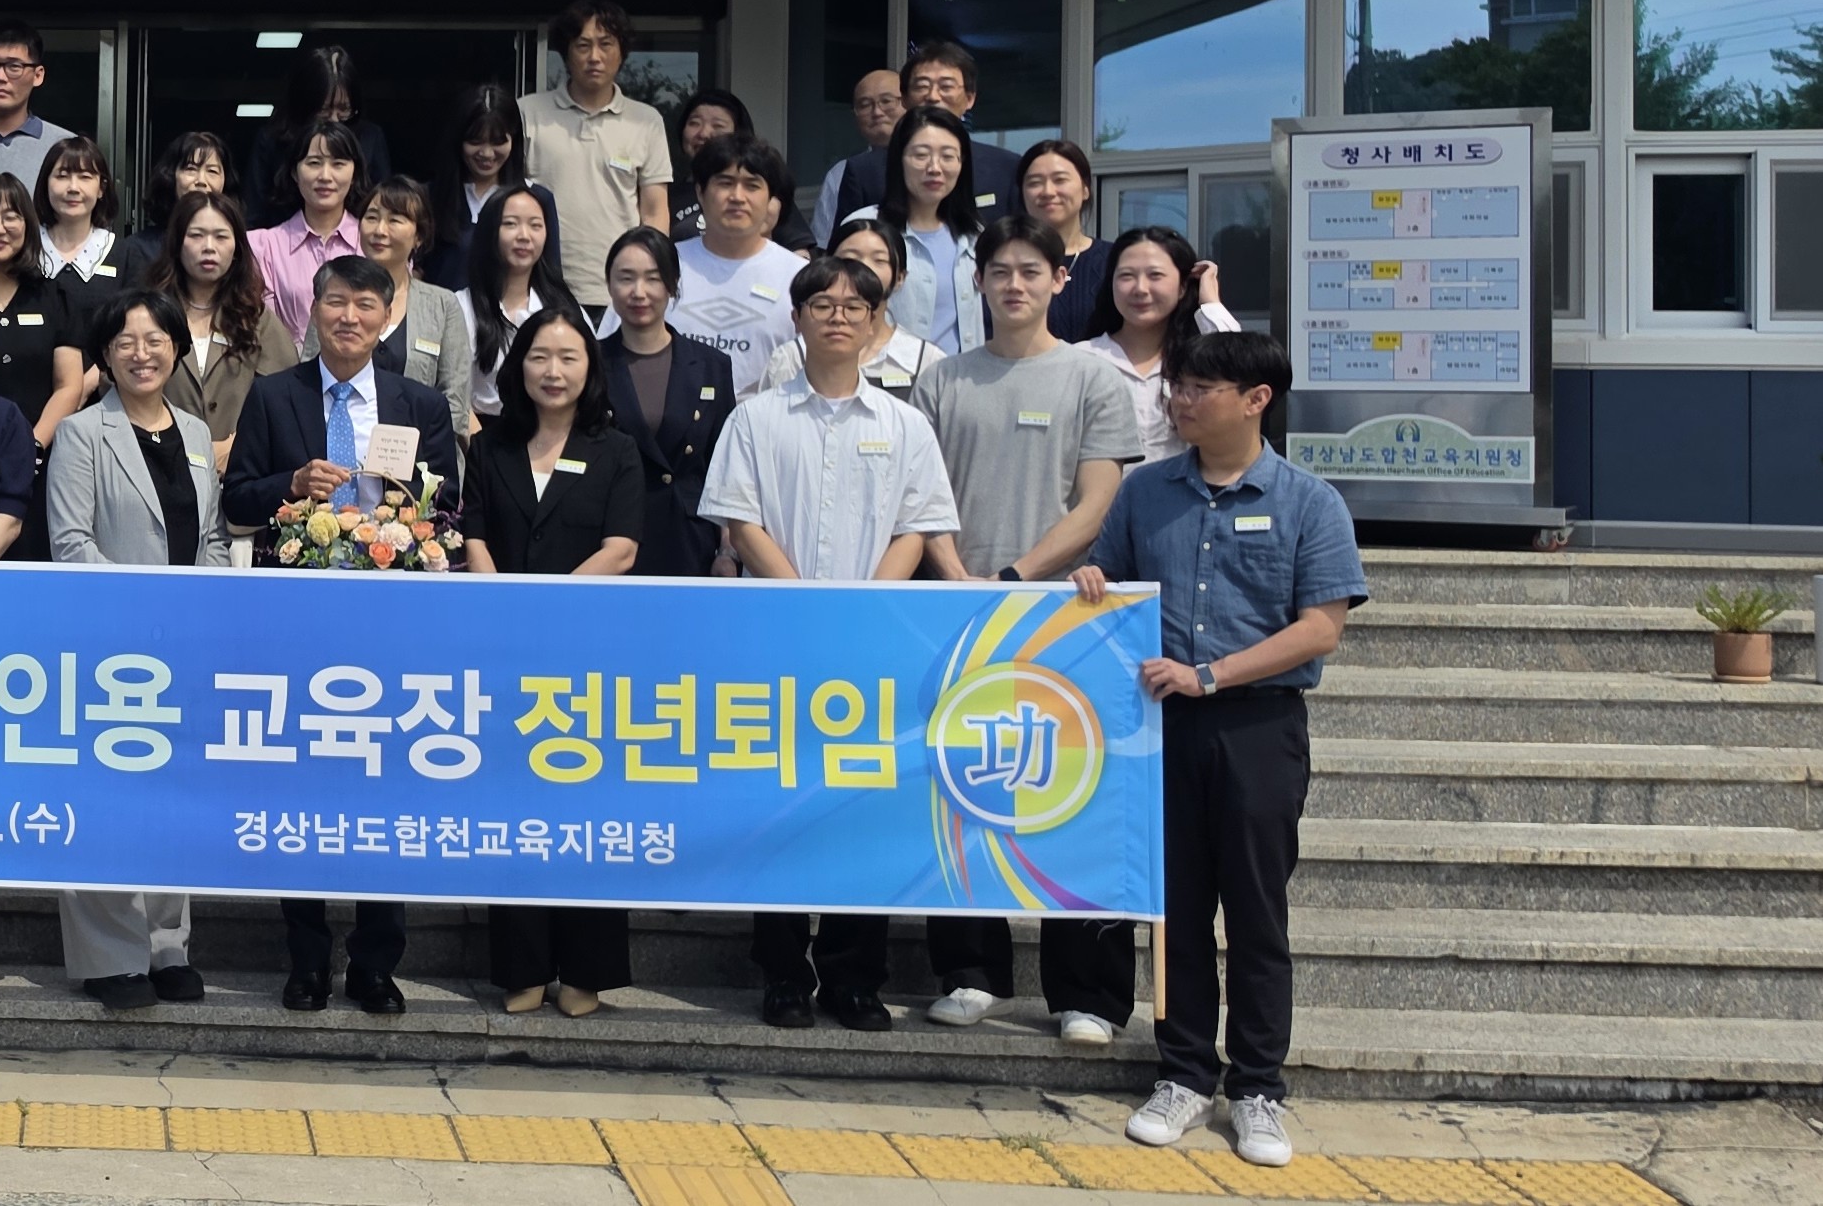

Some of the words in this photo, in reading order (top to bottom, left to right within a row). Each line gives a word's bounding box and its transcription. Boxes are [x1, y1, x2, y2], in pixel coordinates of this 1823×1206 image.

[1340, 143, 1487, 166] 청사배치도
[1298, 445, 1523, 468] 경상남도합천교육지원청
[204, 664, 493, 782] 교육장
[516, 672, 897, 789] 정년퇴임
[964, 703, 1058, 788] 功
[233, 809, 676, 865] 경상남도합천교육지원청
